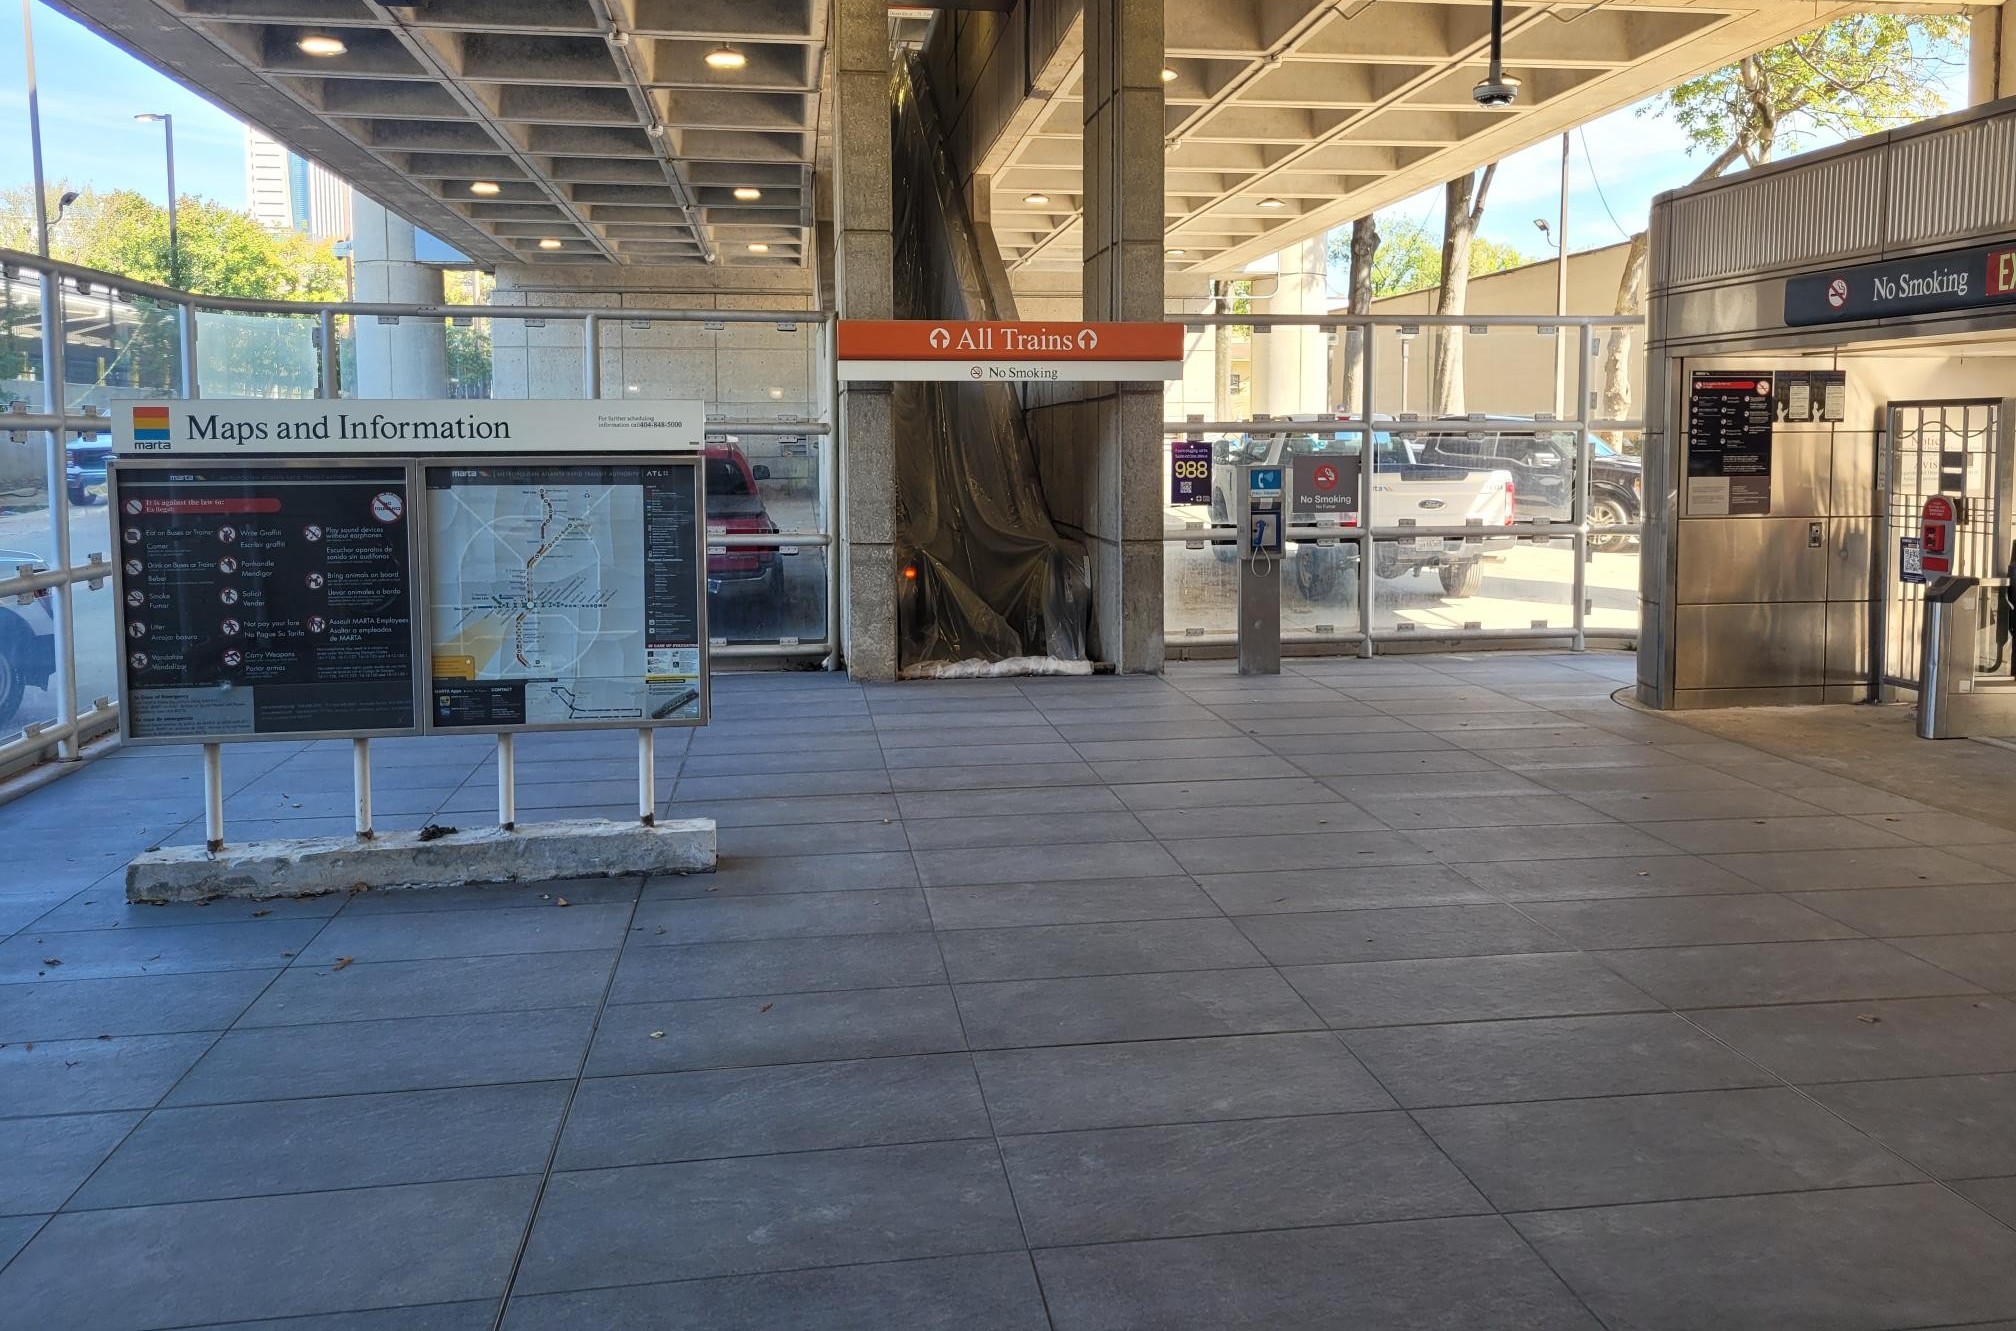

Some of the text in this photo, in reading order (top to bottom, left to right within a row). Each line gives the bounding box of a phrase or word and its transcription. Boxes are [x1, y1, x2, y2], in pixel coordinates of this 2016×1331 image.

[1872, 268, 1968, 300] No Smoking
[956, 328, 1073, 350] All Trains
[989, 366, 1058, 380] No Smoking
[186, 414, 512, 446] Maps and Information
[134, 441, 171, 450] marta
[1175, 461, 1208, 478] 988
[1300, 495, 1351, 504] No Smoking
